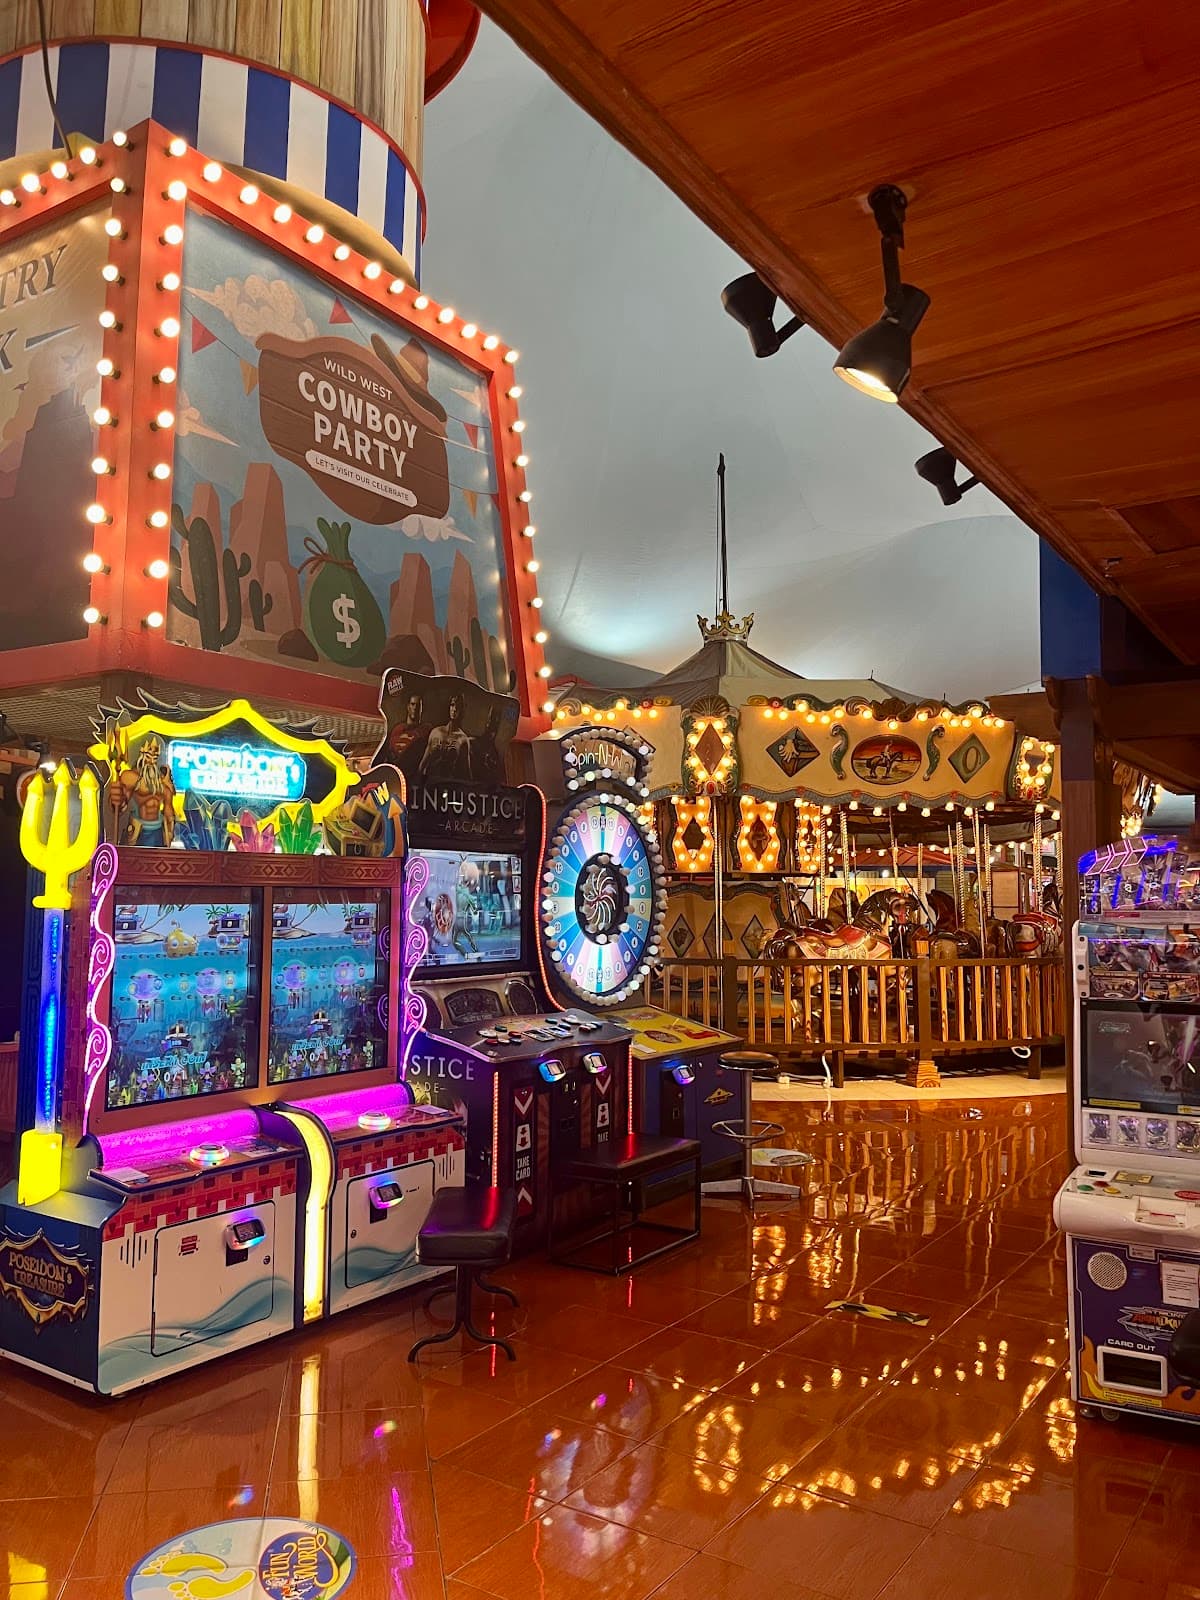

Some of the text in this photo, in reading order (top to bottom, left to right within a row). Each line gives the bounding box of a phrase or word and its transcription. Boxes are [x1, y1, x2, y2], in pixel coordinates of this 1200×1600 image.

[323, 357, 393, 401] WILD WEST
[298, 371, 418, 449] COWBOY
[313, 411, 407, 478] PARTY
[315, 456, 409, 501] LET'S VISIT OUR CELEBRATE
[411, 785, 522, 820] INJUSTICE
[515, 1166, 531, 1182] CARD
[517, 1155, 530, 1169] TAKE
[1107, 1338, 1156, 1352] CARD OUT
